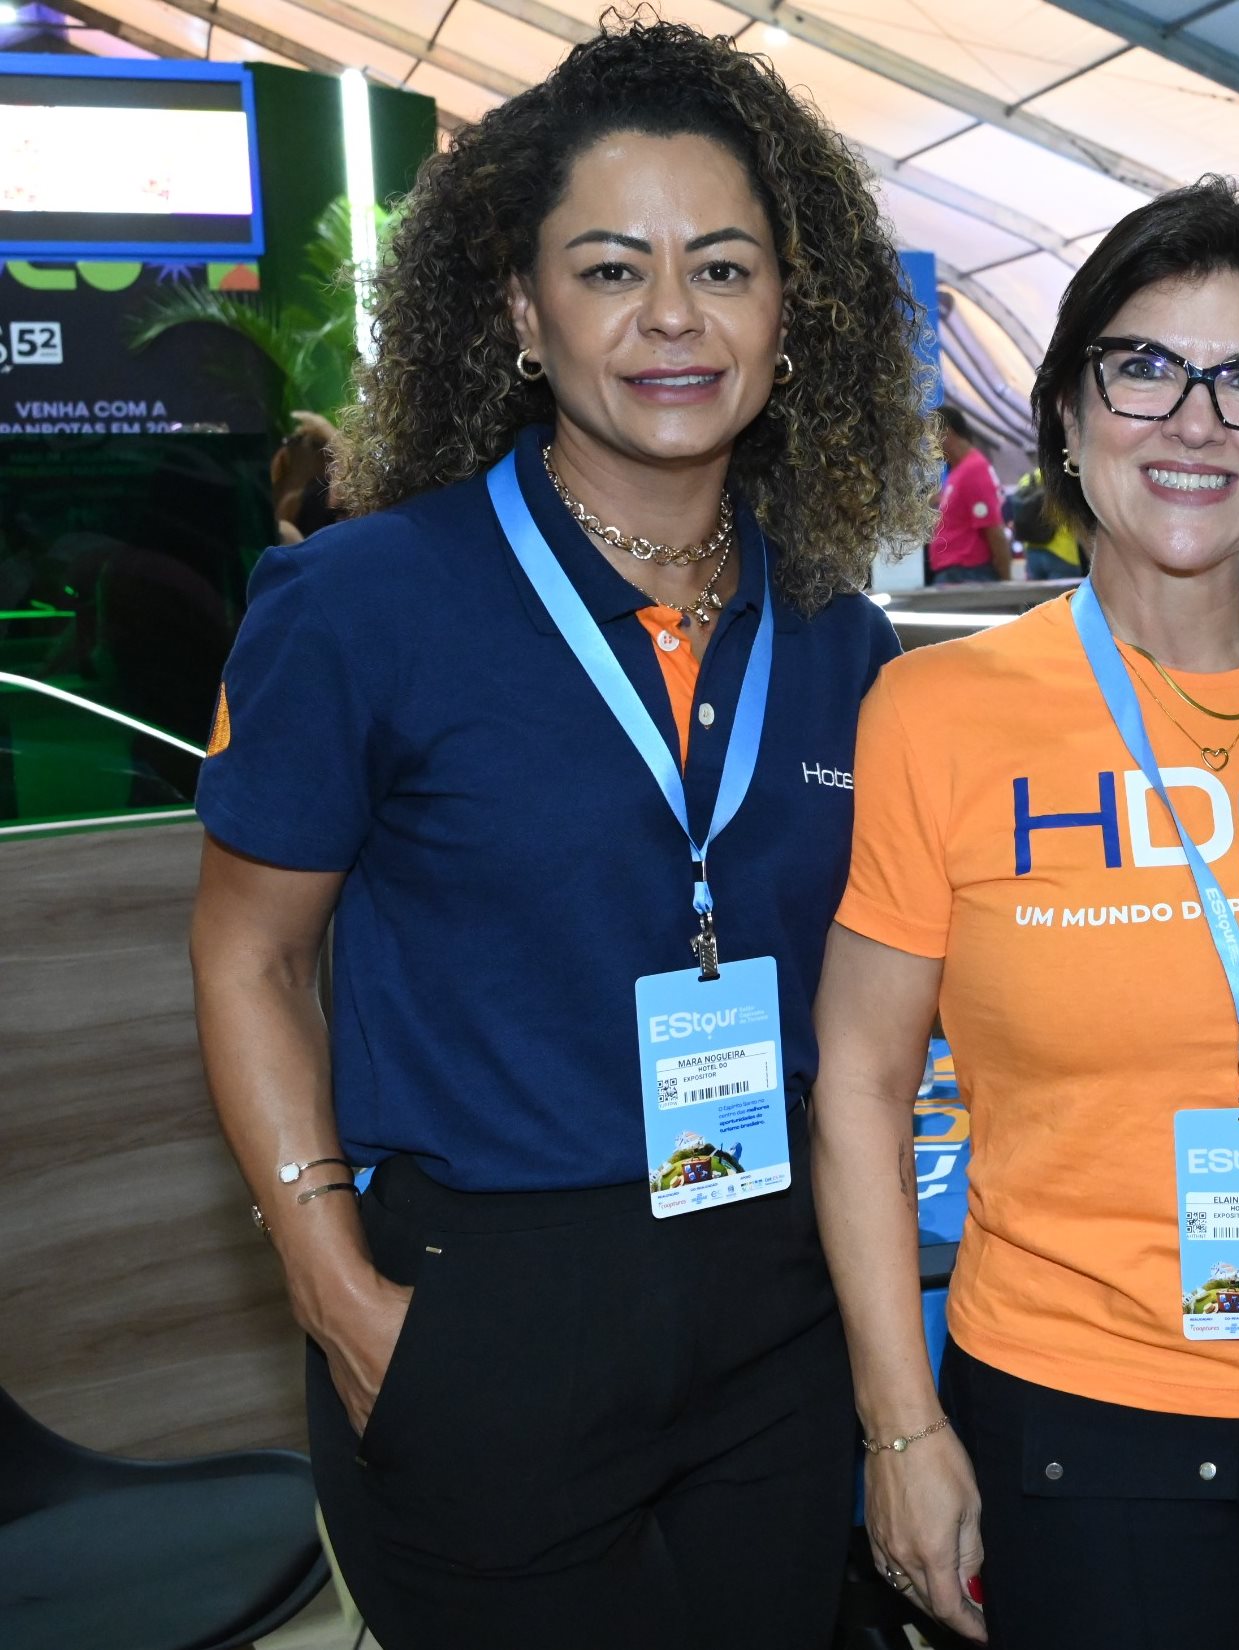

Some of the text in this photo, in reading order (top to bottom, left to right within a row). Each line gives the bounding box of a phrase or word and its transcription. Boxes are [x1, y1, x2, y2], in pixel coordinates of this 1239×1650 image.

[17, 327, 57, 358] 52
[16, 401, 167, 418] VENHA COM A
[802, 762, 853, 789] Hote
[1015, 905, 1054, 927] UM
[1062, 902, 1173, 927] MUNDO
[1183, 901, 1207, 921] D
[649, 1007, 738, 1043] EStour
[678, 1050, 746, 1068] MARA NOGUEIRA
[698, 1064, 718, 1072] HOTEL
[683, 1072, 717, 1083] EXPOSITOR
